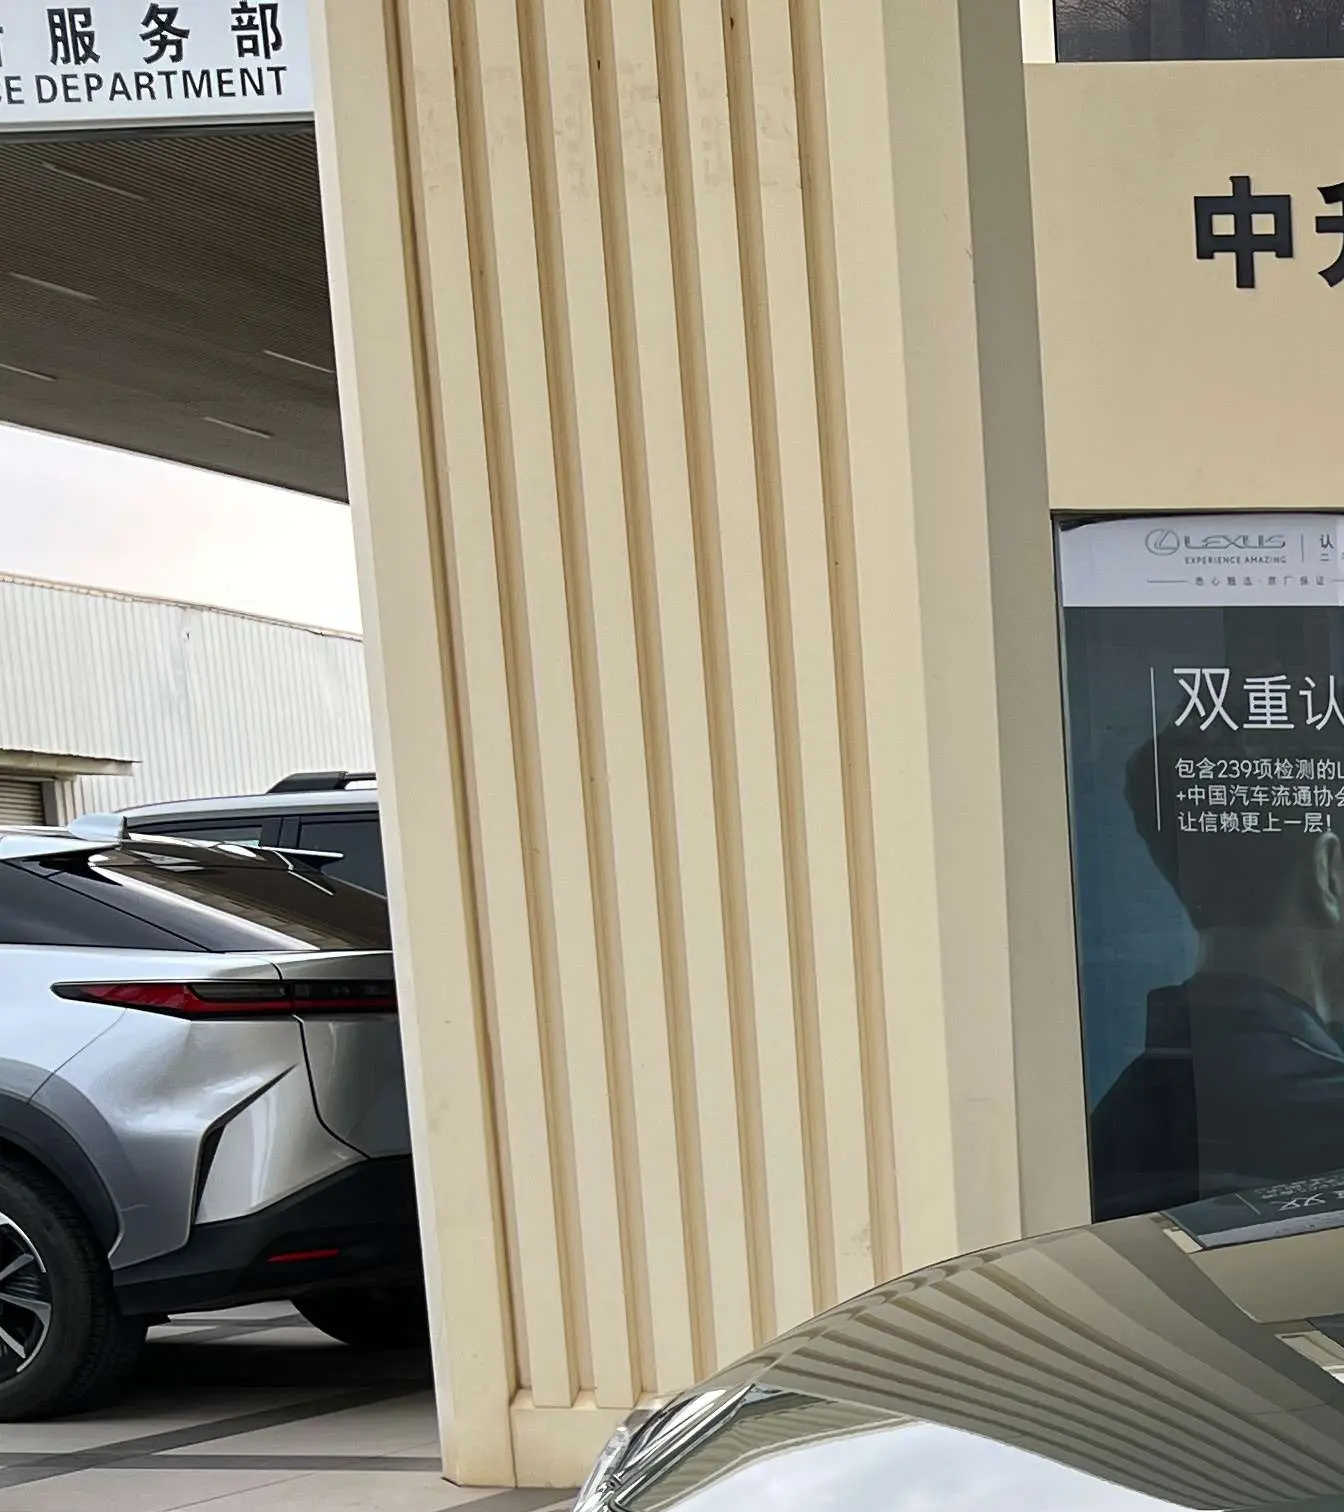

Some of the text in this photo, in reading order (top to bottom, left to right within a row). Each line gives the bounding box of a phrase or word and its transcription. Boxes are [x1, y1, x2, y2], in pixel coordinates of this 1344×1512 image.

[0, 1, 283, 67] 服务部
[35, 66, 287, 104] DEPARTMENT
[1184, 534, 1286, 549] LEXUS
[1185, 556, 1287, 565] EXPERIENCE AMAZING
